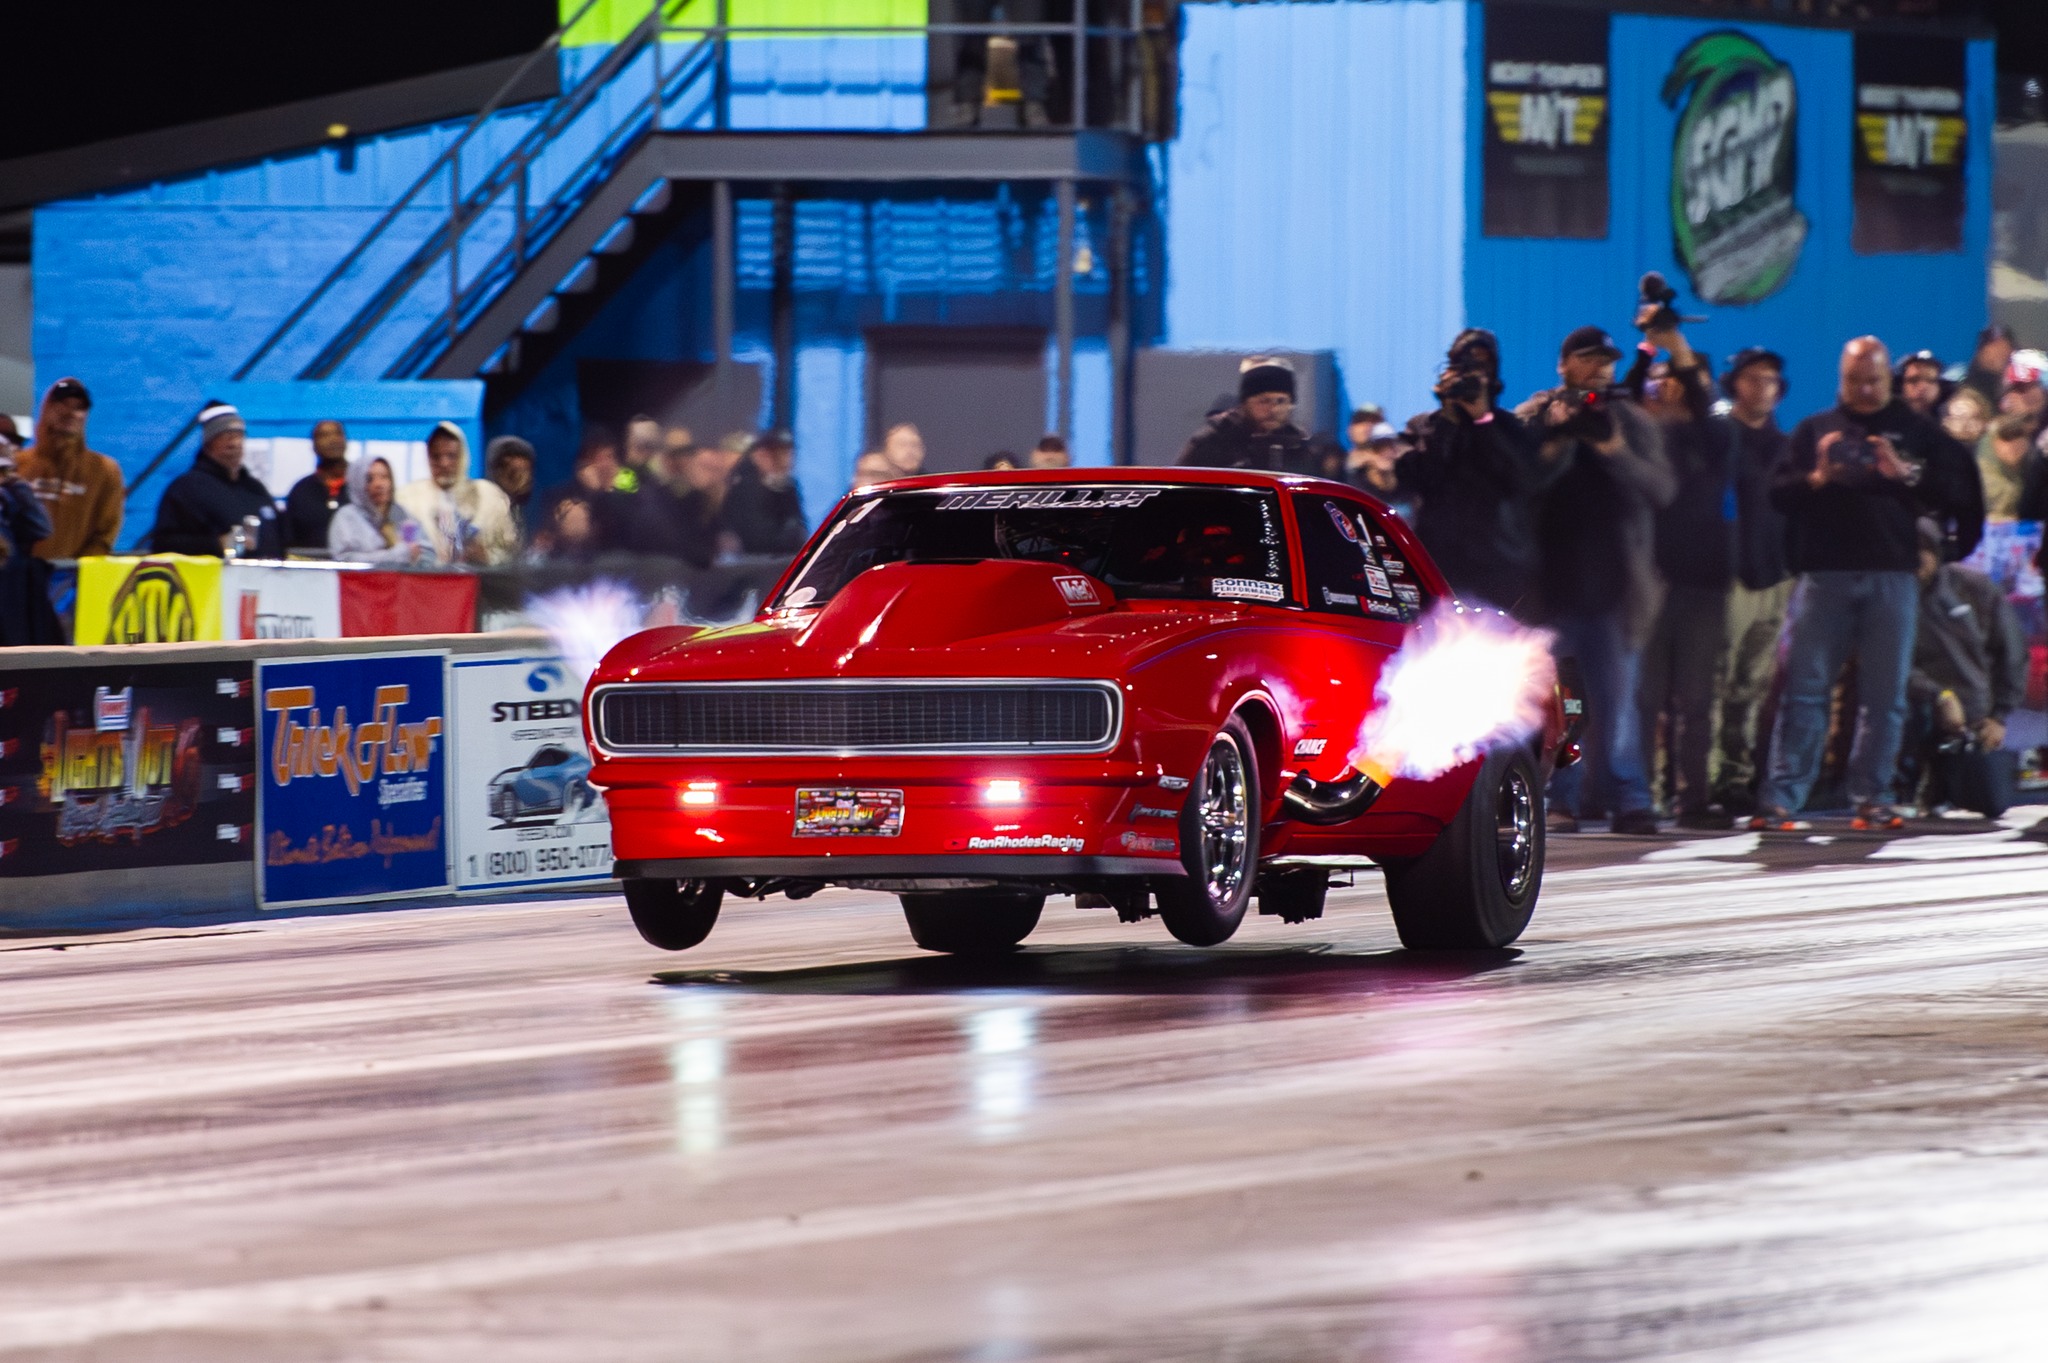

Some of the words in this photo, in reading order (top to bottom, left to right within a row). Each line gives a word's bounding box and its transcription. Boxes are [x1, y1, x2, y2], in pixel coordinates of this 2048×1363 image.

[1214, 579, 1280, 591] sonnax
[1214, 585, 1282, 597] PERFORMANCE
[492, 699, 583, 722] STEED
[968, 834, 1085, 852] RonRhodesRacing
